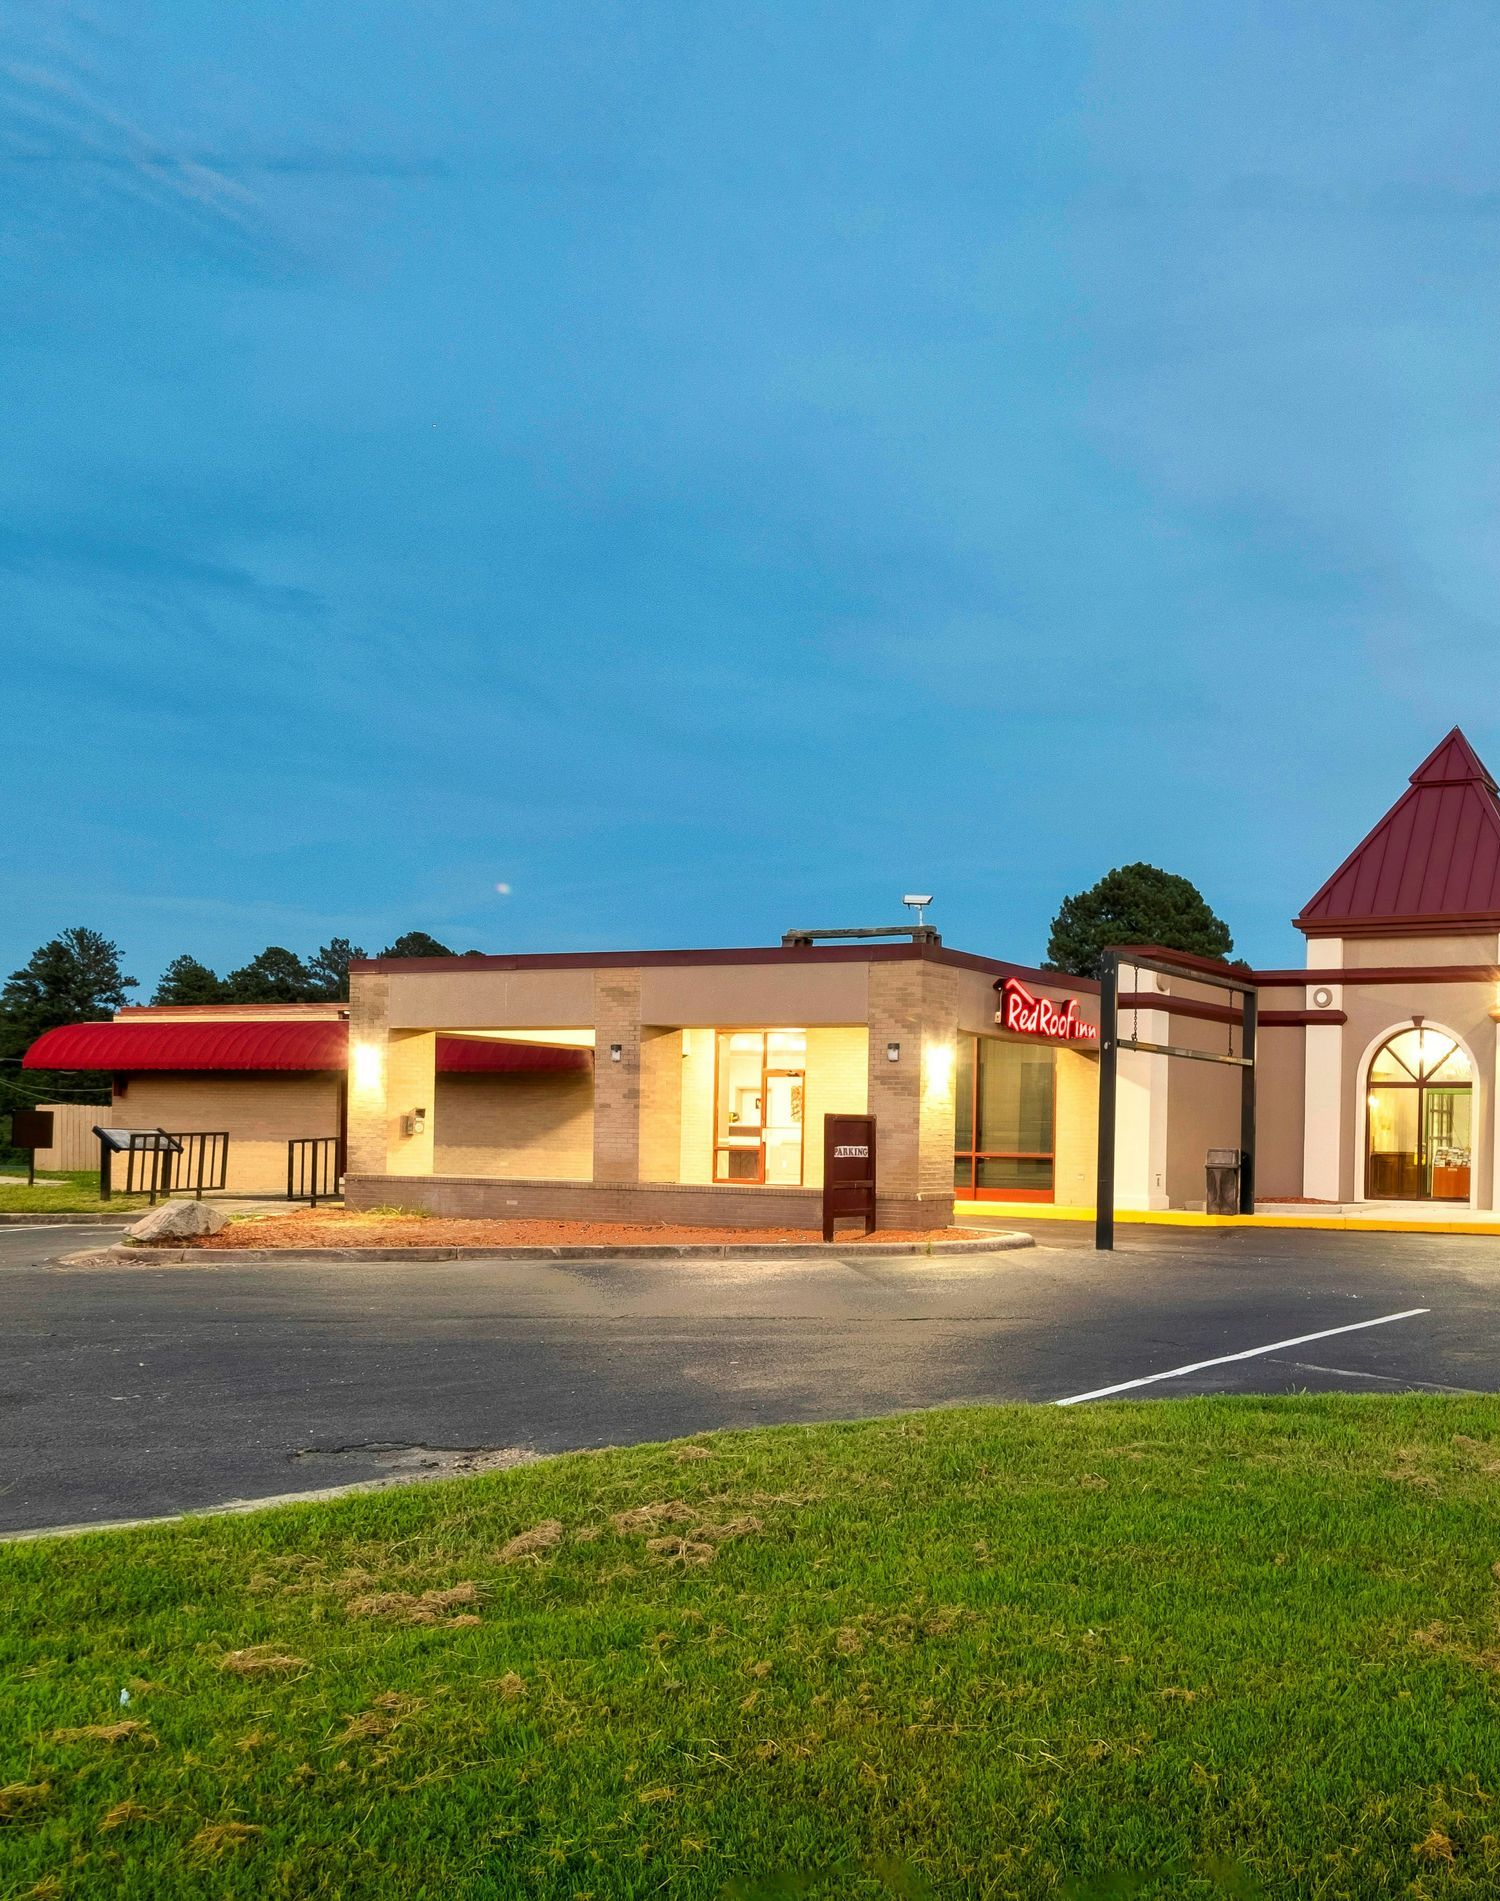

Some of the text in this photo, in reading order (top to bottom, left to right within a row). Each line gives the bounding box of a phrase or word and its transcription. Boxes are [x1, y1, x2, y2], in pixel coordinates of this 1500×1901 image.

[1008, 993, 1039, 1032] Red
[1040, 999, 1078, 1040] Roof
[834, 1147, 868, 1156] PARKING
